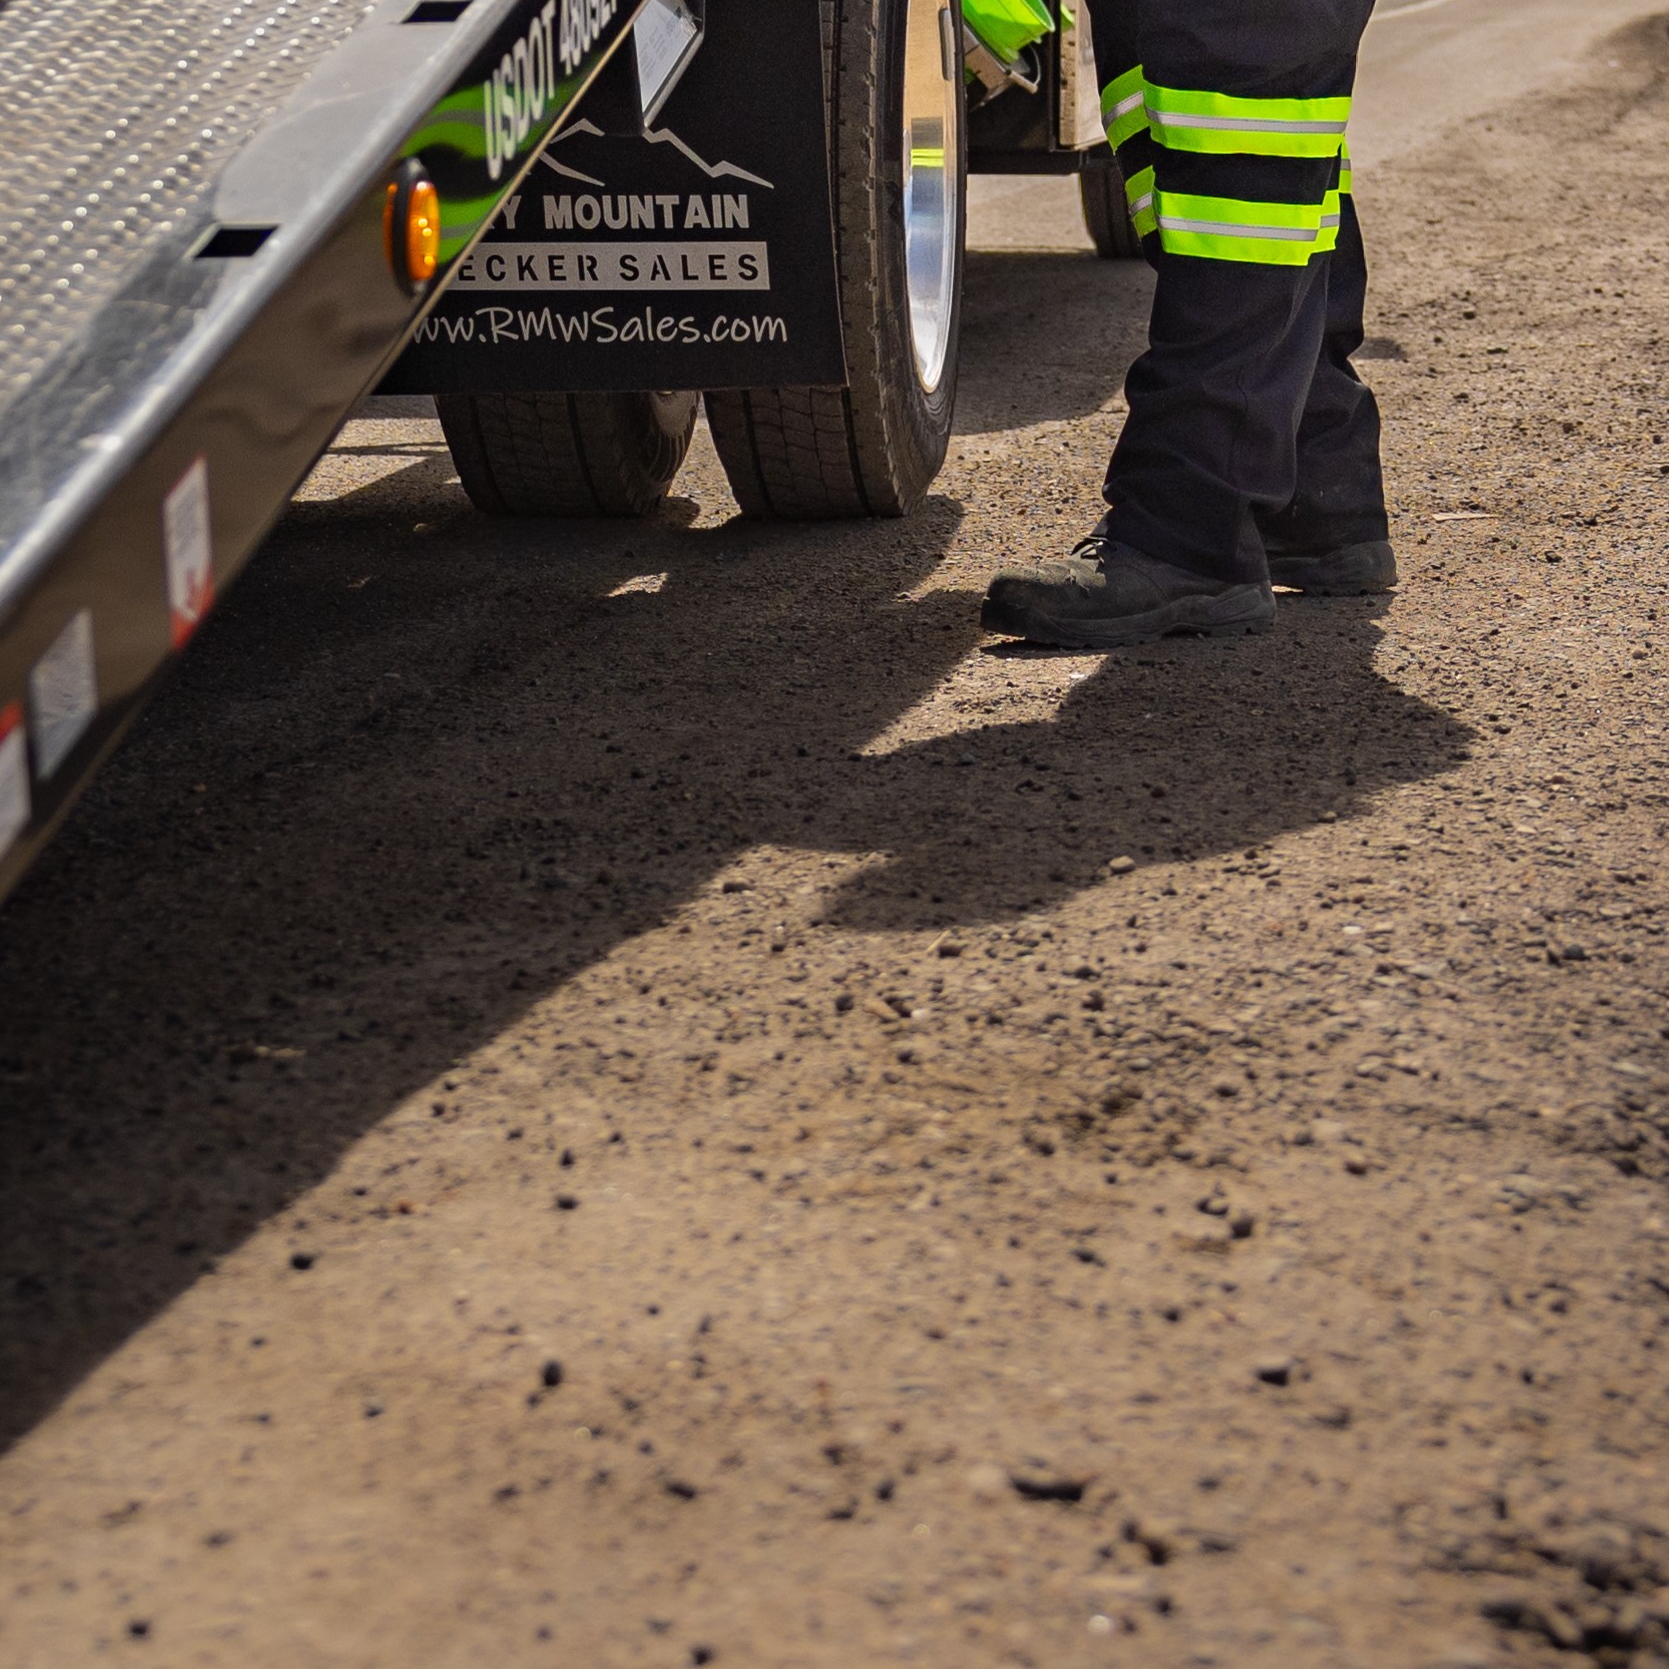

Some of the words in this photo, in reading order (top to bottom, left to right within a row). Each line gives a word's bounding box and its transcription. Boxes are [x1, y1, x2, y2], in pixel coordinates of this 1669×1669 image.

[542, 194, 750, 230] MOUNTAIN
[457, 254, 599, 282] ECKER
[618, 253, 759, 282] SALES
